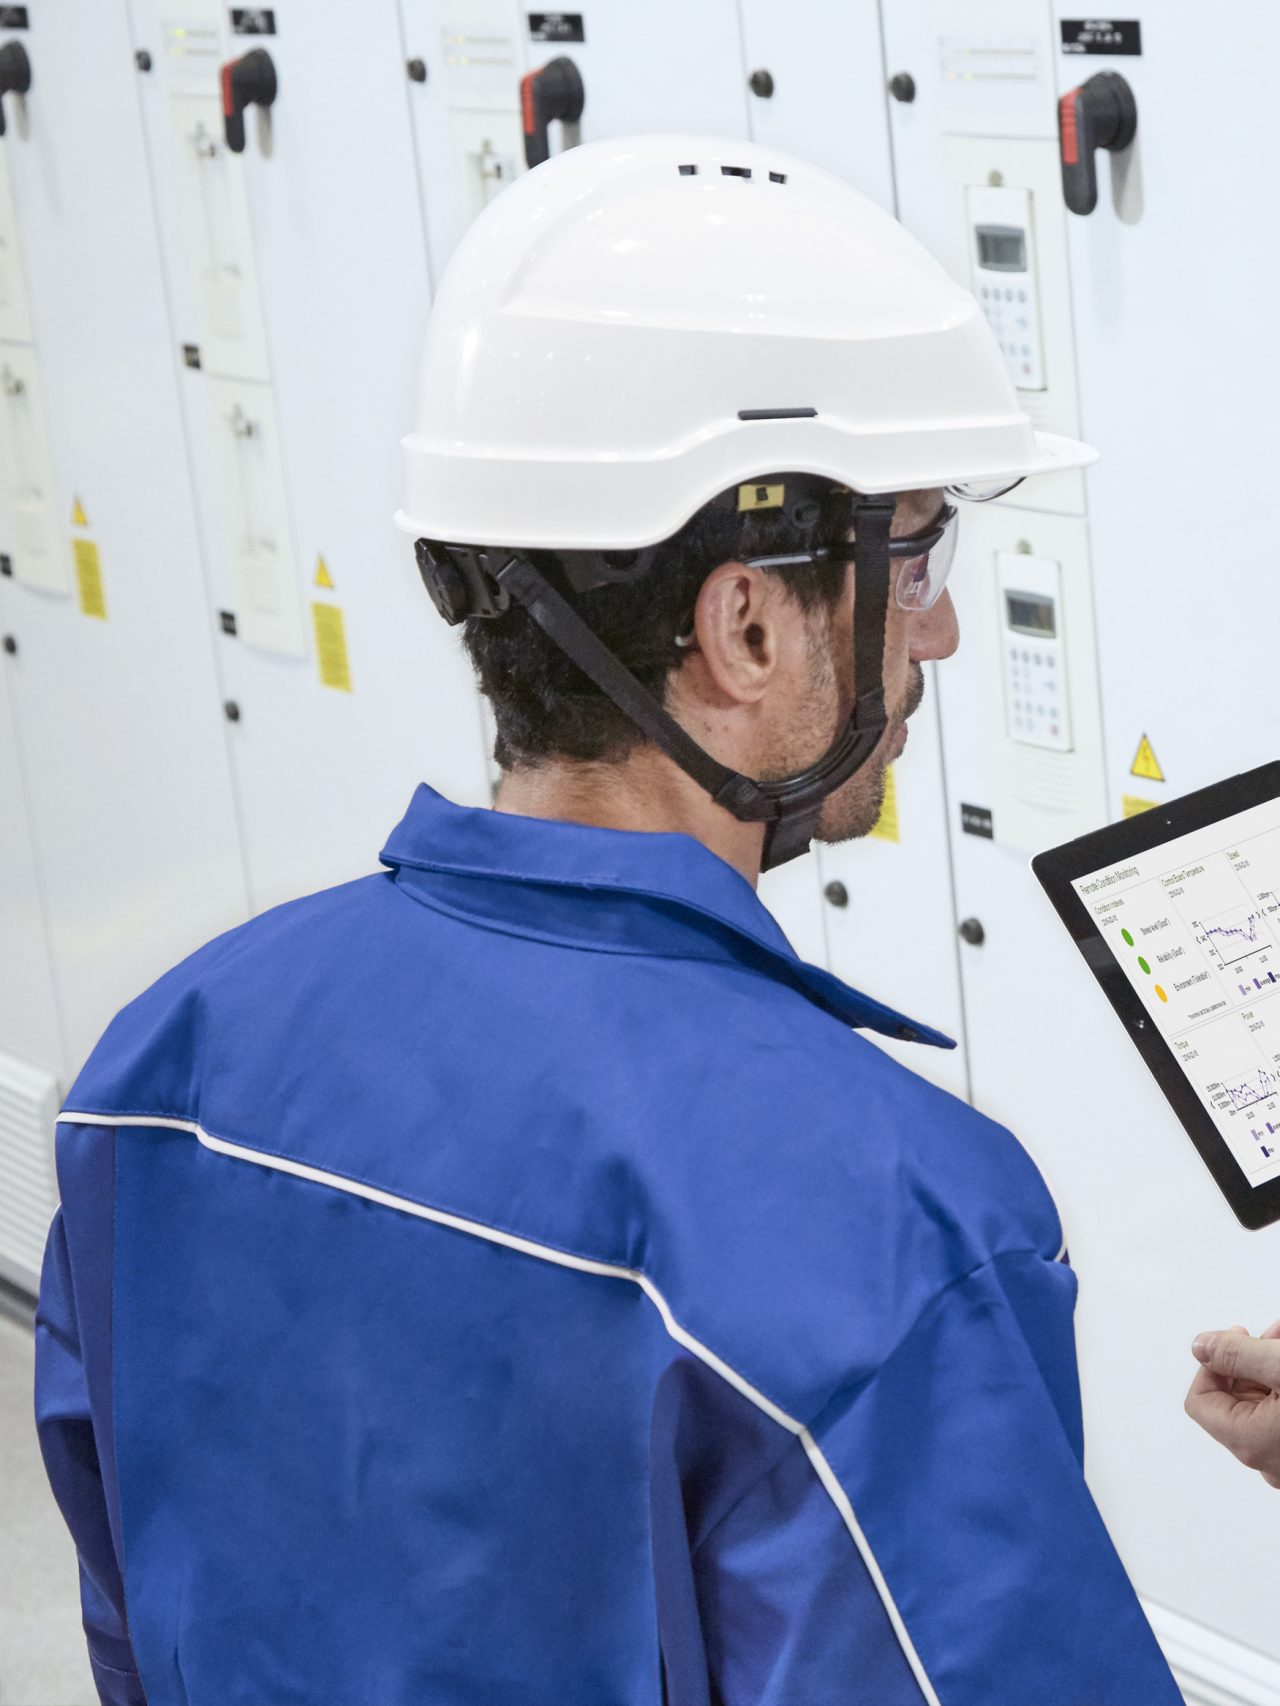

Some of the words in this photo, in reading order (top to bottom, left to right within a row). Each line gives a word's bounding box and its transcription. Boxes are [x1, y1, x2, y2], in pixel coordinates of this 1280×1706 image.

[1079, 882, 1098, 894] Remote
[1095, 874, 1118, 888] Condition
[1114, 866, 1140, 881] Monitoring
[1161, 876, 1175, 887] Control
[1172, 873, 1185, 882] Board
[1182, 865, 1205, 878] Temperature
[1094, 904, 1111, 915] Condition
[1140, 926, 1152, 935] Stress
[1173, 978, 1194, 992] Environment
